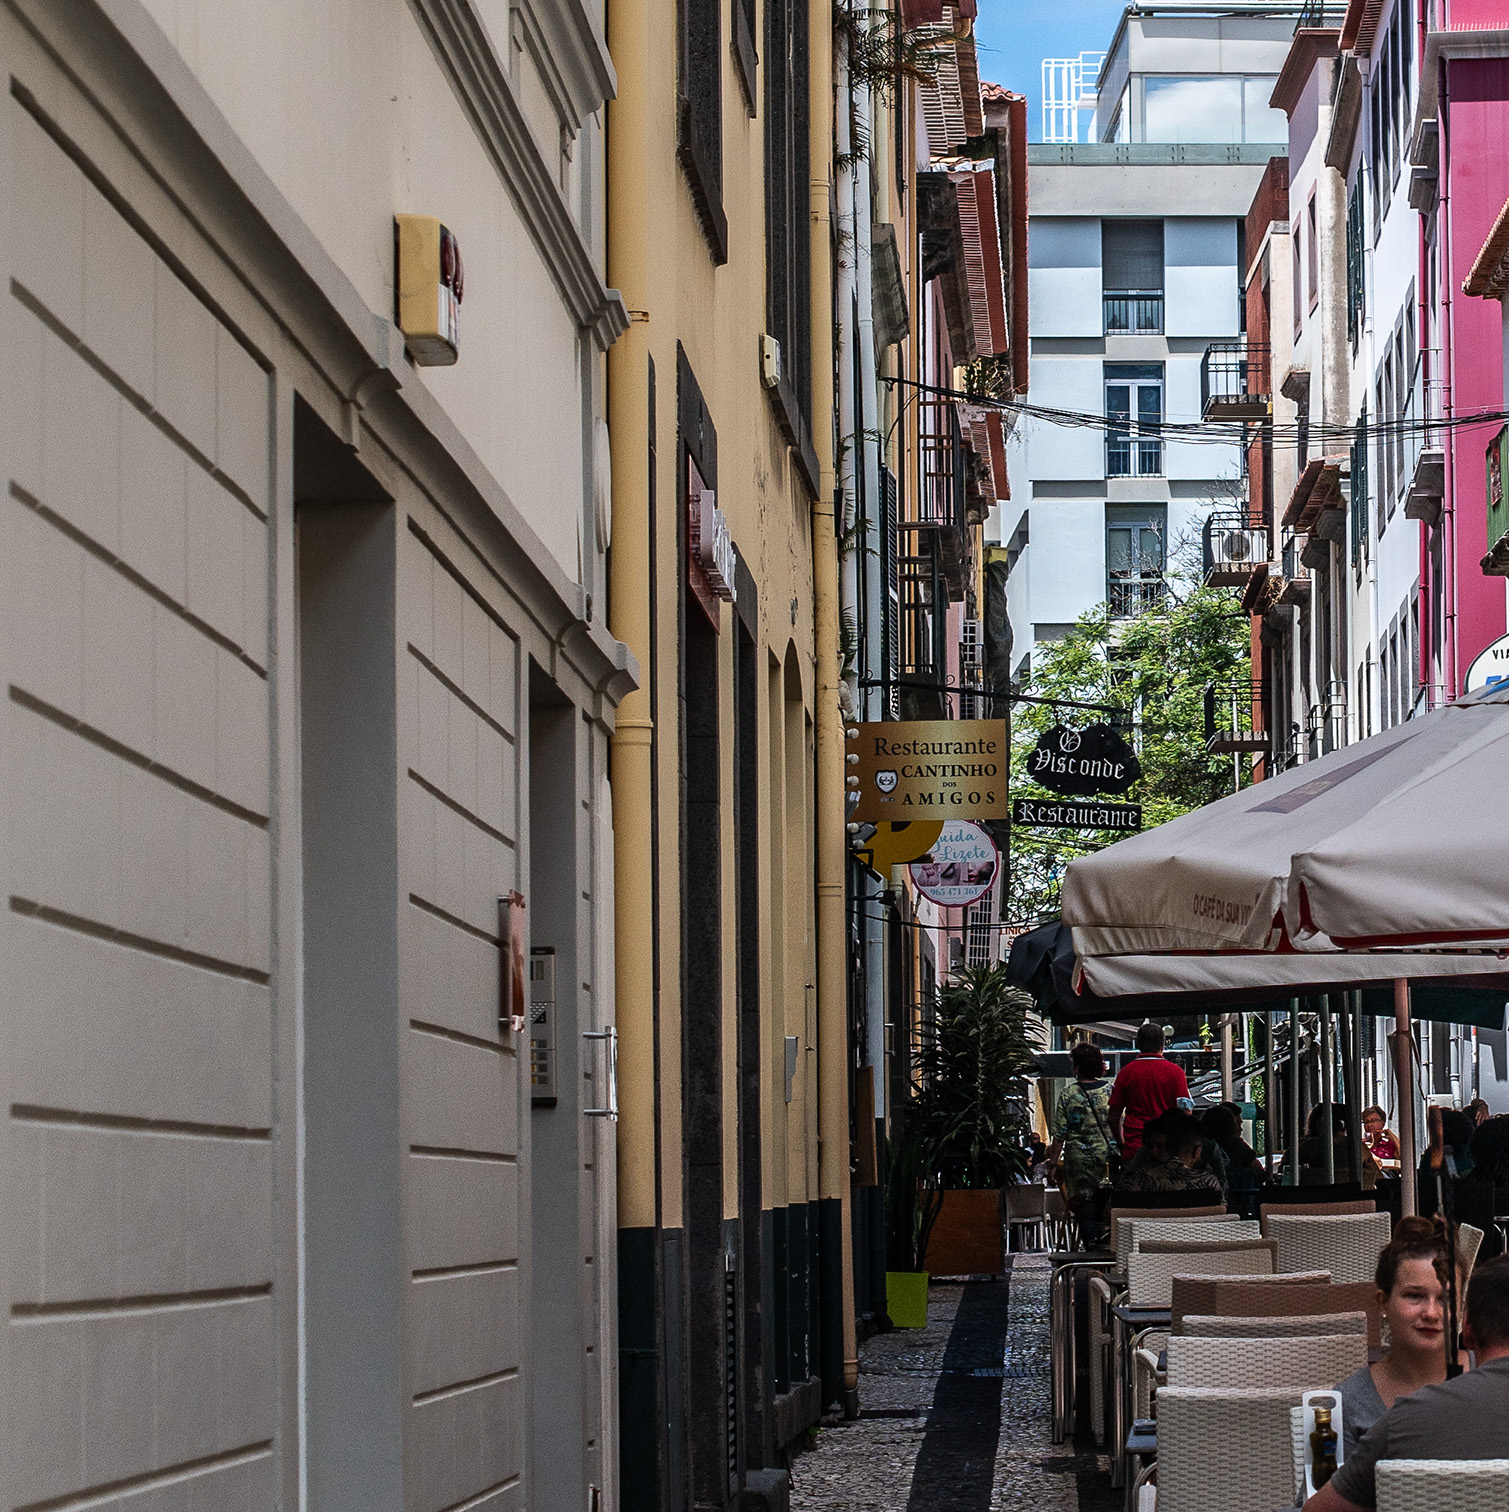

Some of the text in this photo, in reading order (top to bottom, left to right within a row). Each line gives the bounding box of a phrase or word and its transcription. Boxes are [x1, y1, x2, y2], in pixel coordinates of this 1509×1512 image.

[873, 737, 997, 757] Restaurante
[901, 763, 997, 778] CANTINHO
[1034, 747, 1125, 779] Visconde
[901, 791, 996, 806] AMIGOS
[1019, 801, 1138, 827] Restaurante
